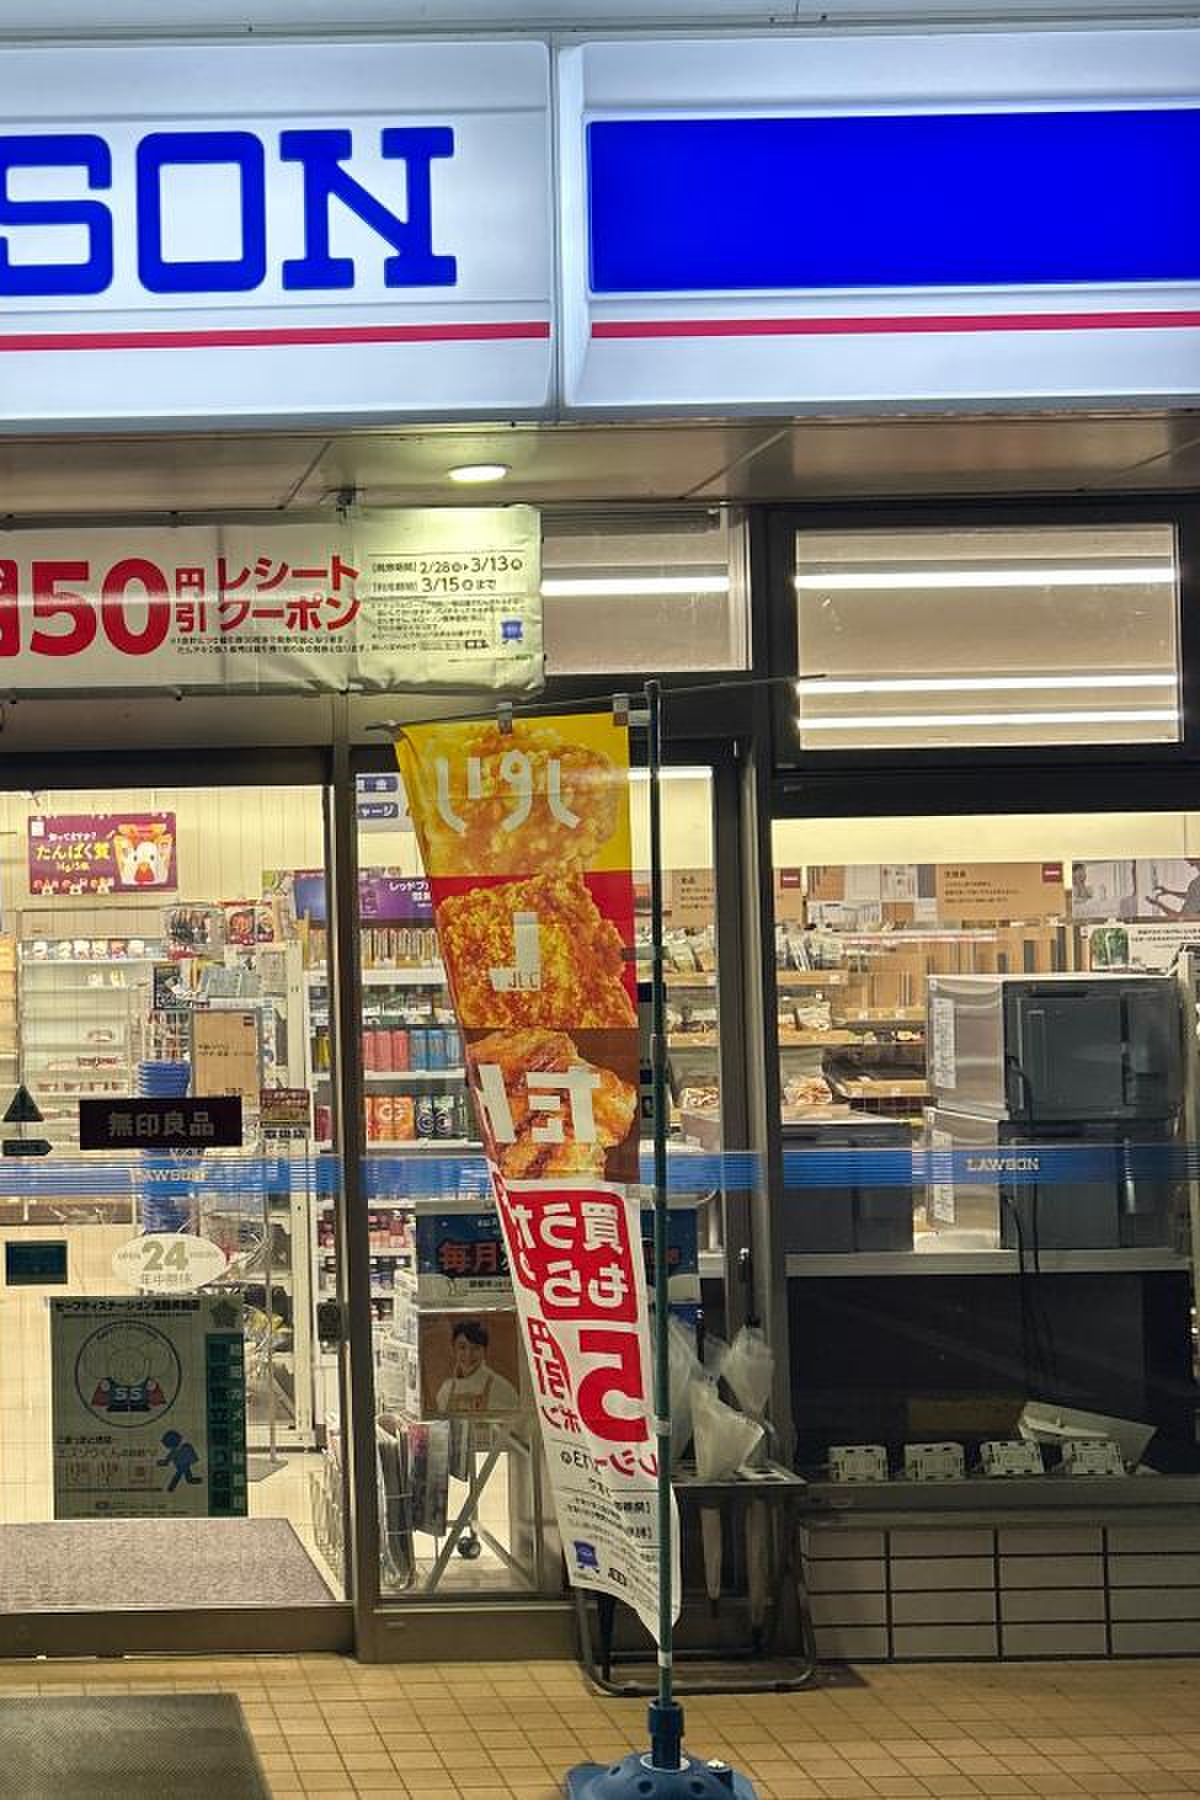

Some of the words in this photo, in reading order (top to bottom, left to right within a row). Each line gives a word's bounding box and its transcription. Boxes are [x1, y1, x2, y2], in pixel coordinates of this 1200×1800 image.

[217, 555, 360, 591] レシート
[30, 557, 170, 656] 50
[217, 596, 361, 632] クーポン
[108, 1111, 215, 1137] 無印良品
[965, 1156, 1040, 1172] LAWSON
[142, 1241, 190, 1271] 24
